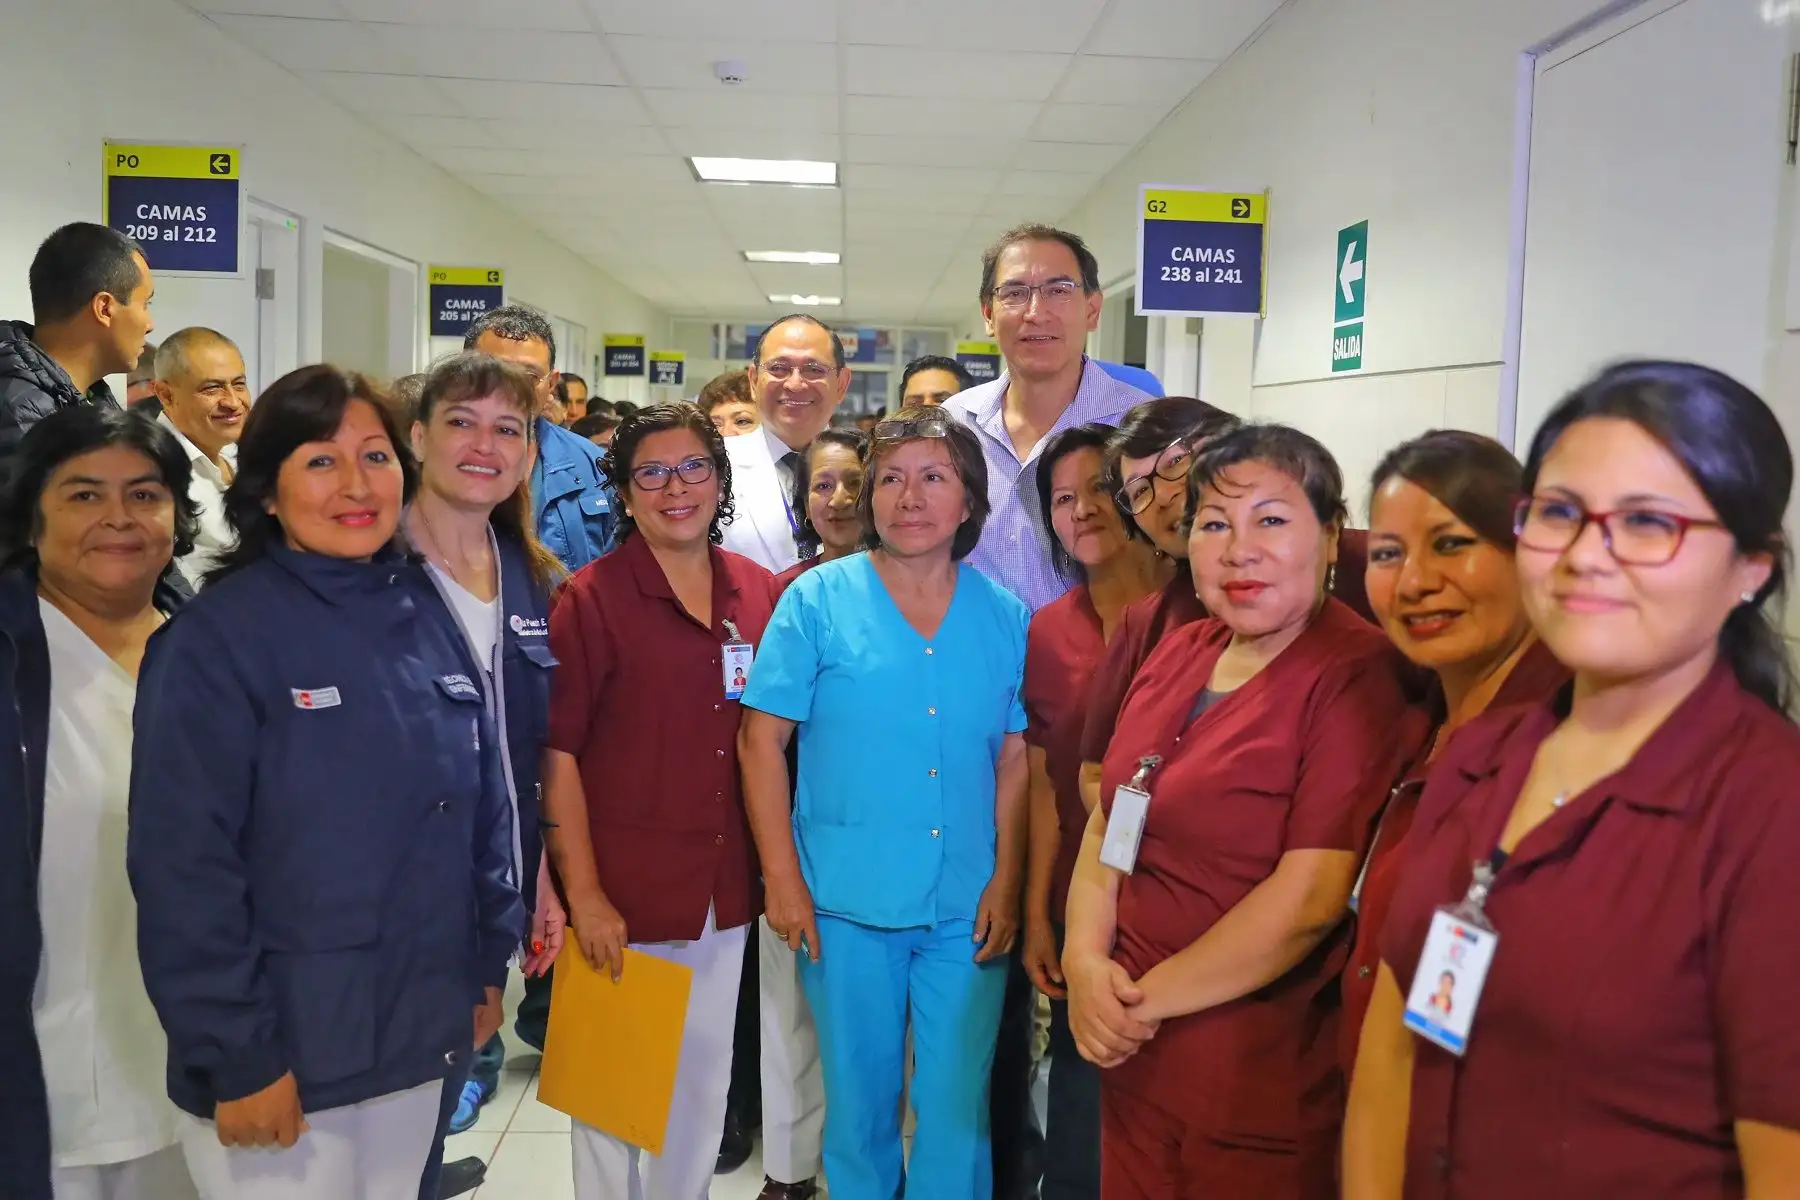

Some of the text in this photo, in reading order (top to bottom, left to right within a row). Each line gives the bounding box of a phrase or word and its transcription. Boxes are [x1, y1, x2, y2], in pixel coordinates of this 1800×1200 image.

[116, 154, 140, 169] PO
[136, 204, 207, 222] CAMAS
[1147, 199, 1167, 213] G2
[125, 224, 217, 243] 209 al 212
[1171, 246, 1235, 264] CAMAS
[432, 272, 447, 281] PO
[1160, 266, 1243, 284] 238 al 241
[445, 299, 486, 310] CAMAS
[440, 311, 458, 321] 205
[461, 311, 471, 321] al
[1333, 334, 1361, 361] SALIDA
